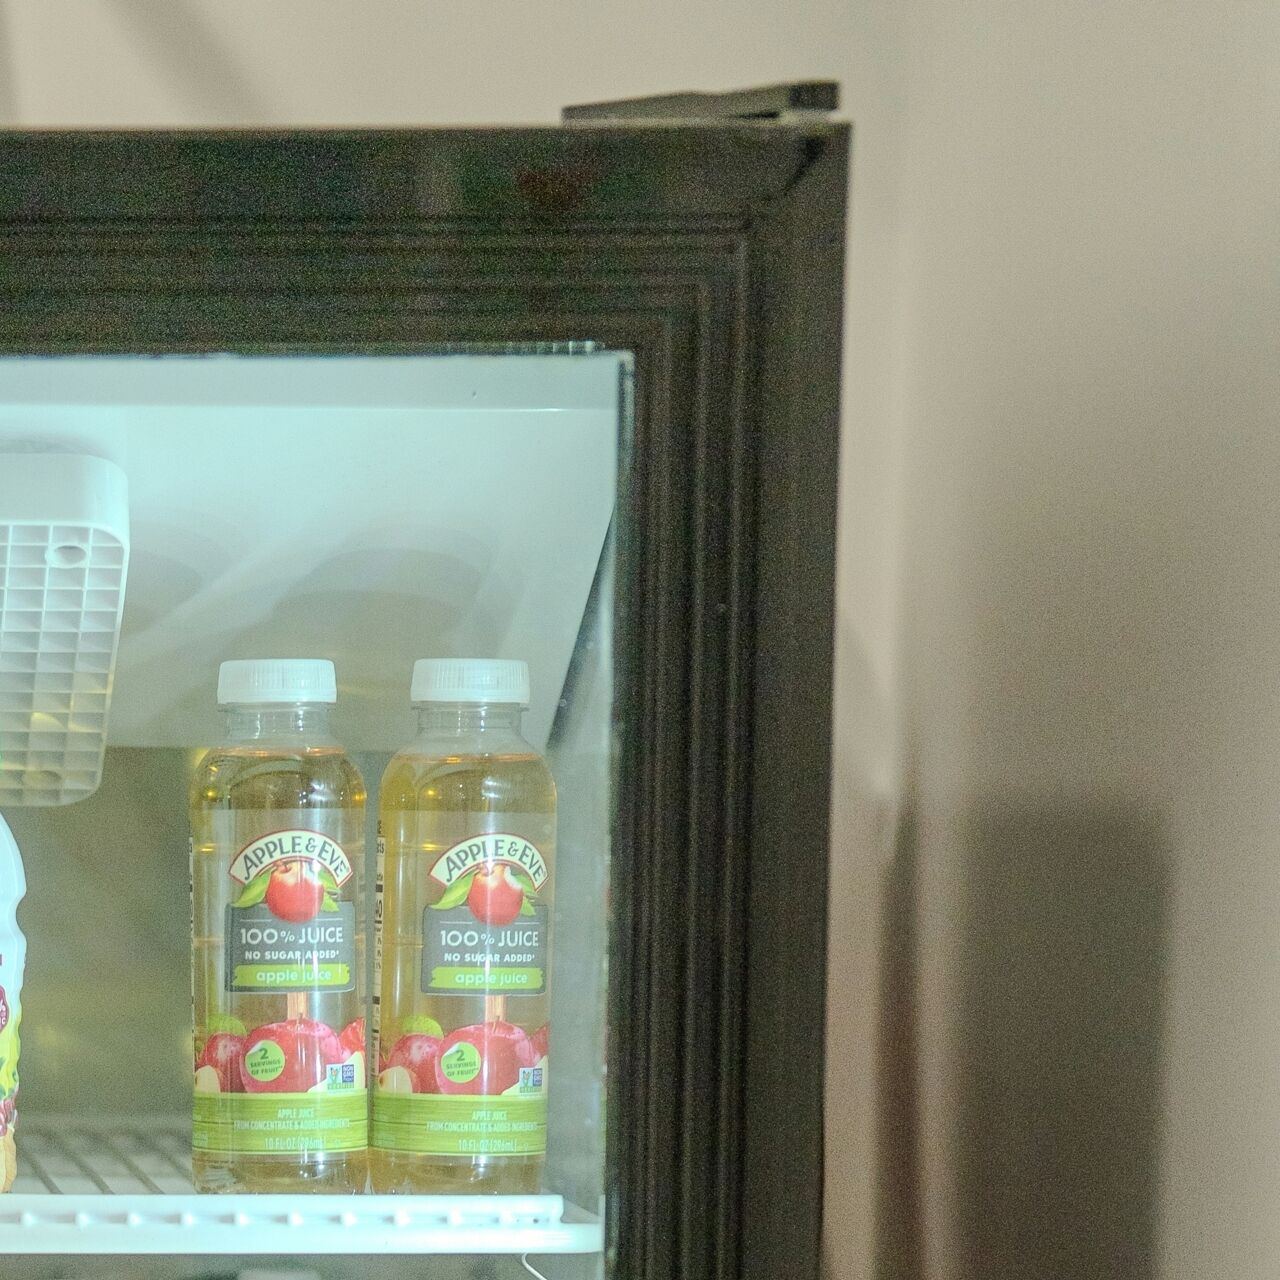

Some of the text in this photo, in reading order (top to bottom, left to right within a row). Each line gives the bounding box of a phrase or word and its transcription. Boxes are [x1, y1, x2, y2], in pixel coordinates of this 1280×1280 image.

[244, 836, 347, 880] APPLE & EVE
[446, 840, 544, 883] APPLE & EVE
[240, 927, 344, 945] 100% JUICE
[440, 930, 539, 946] 100% JUICE
[500, 972, 528, 984] juice
[260, 1048, 269, 1060] 2
[456, 1050, 465, 1061] 2
